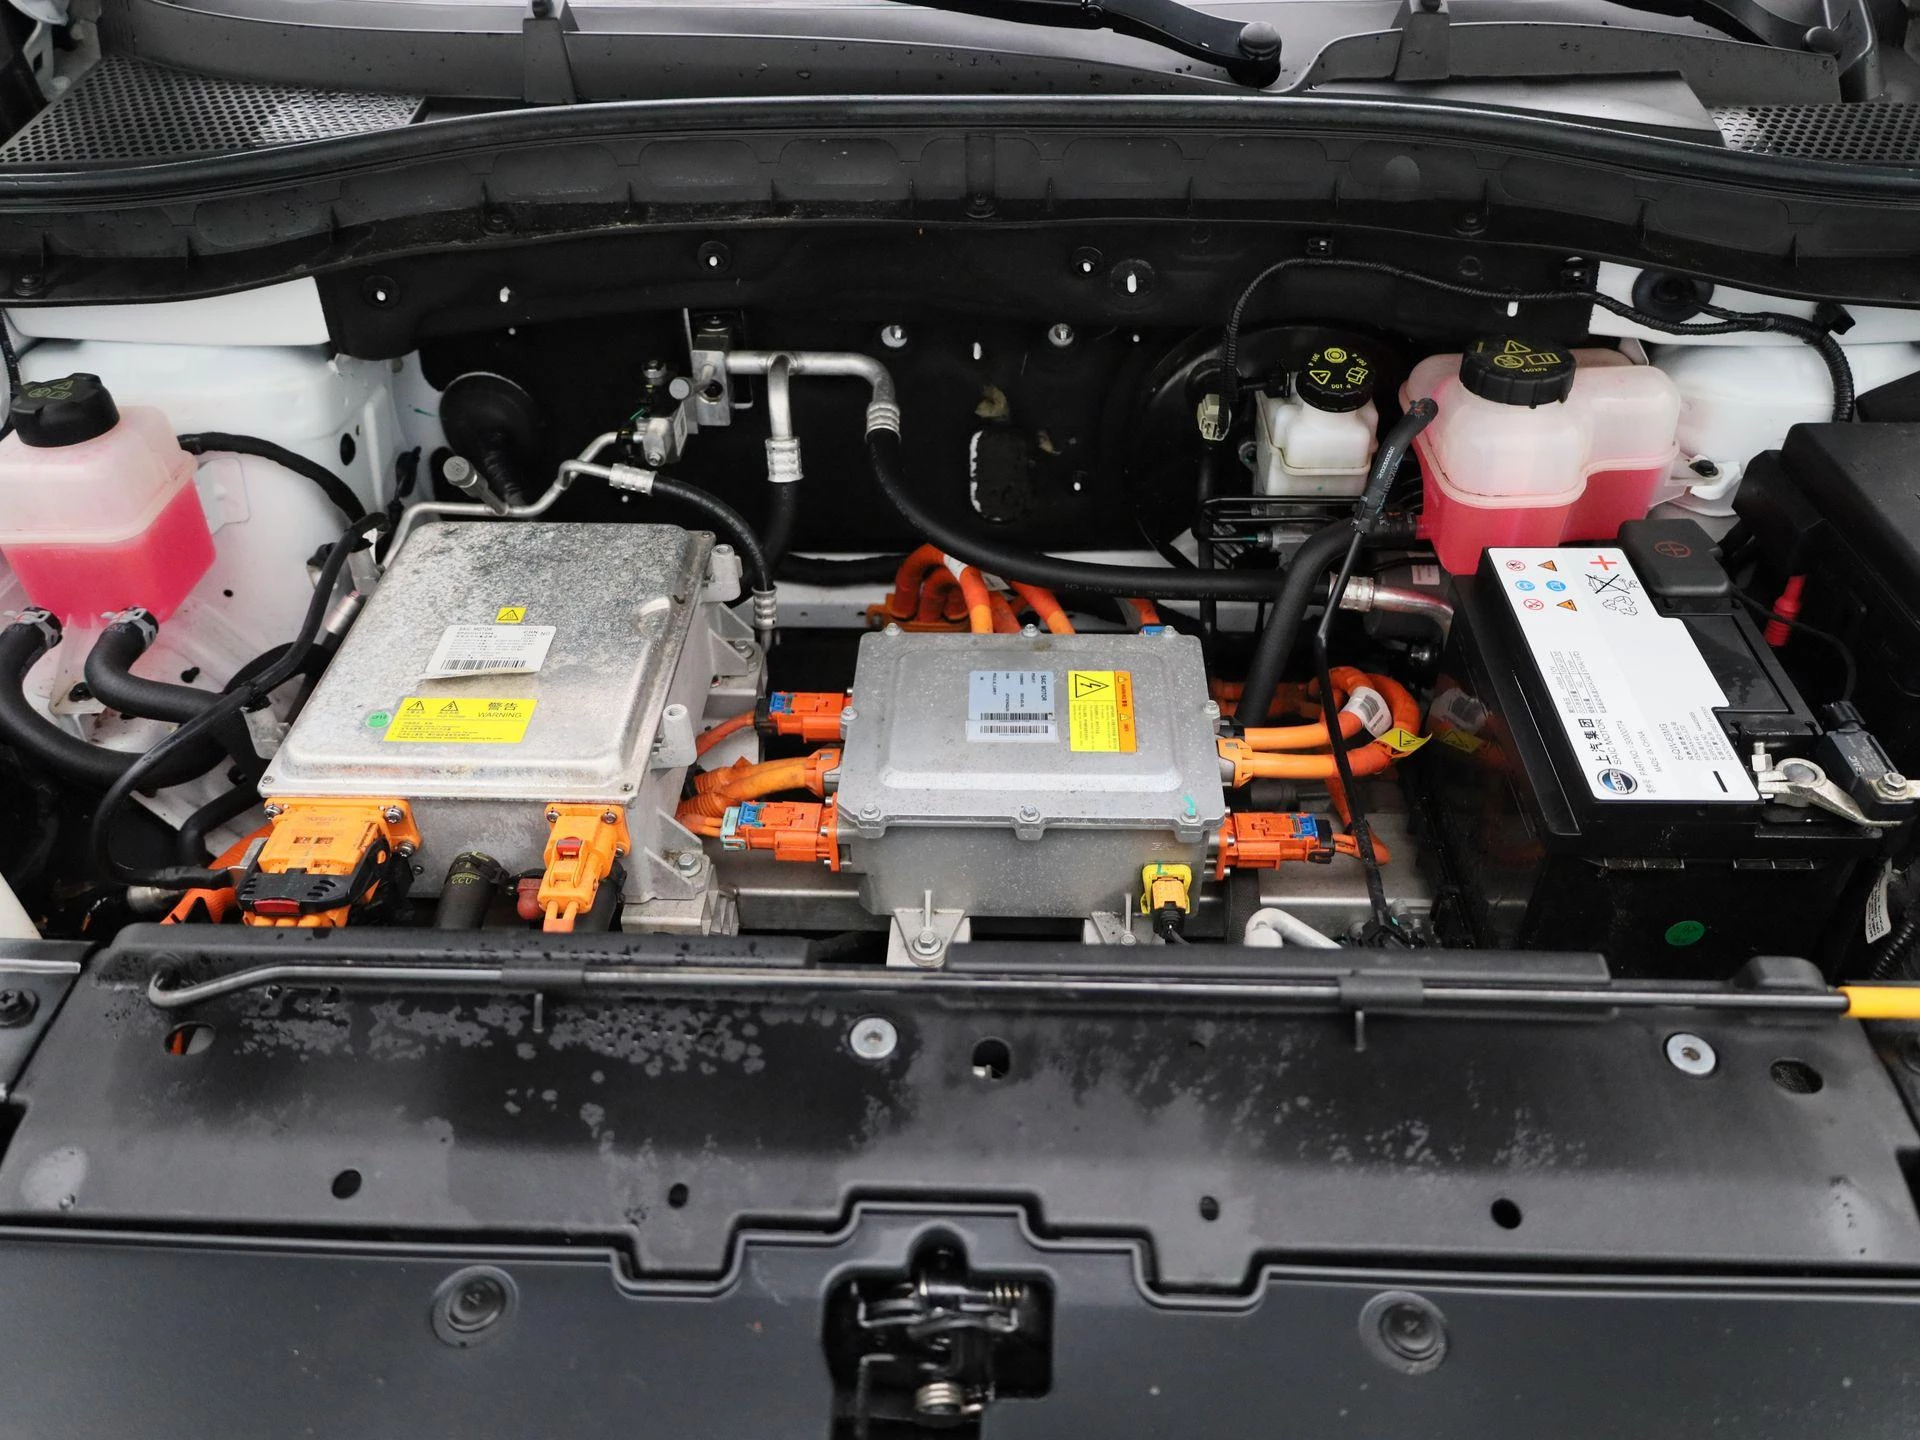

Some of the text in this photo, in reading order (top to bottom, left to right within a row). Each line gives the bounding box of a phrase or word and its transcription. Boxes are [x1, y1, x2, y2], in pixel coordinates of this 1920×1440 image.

[1577, 718, 1611, 764] 上汽集团
[1595, 718, 1622, 764] SAIC MOTOR
[1611, 771, 1626, 791] SAIC
